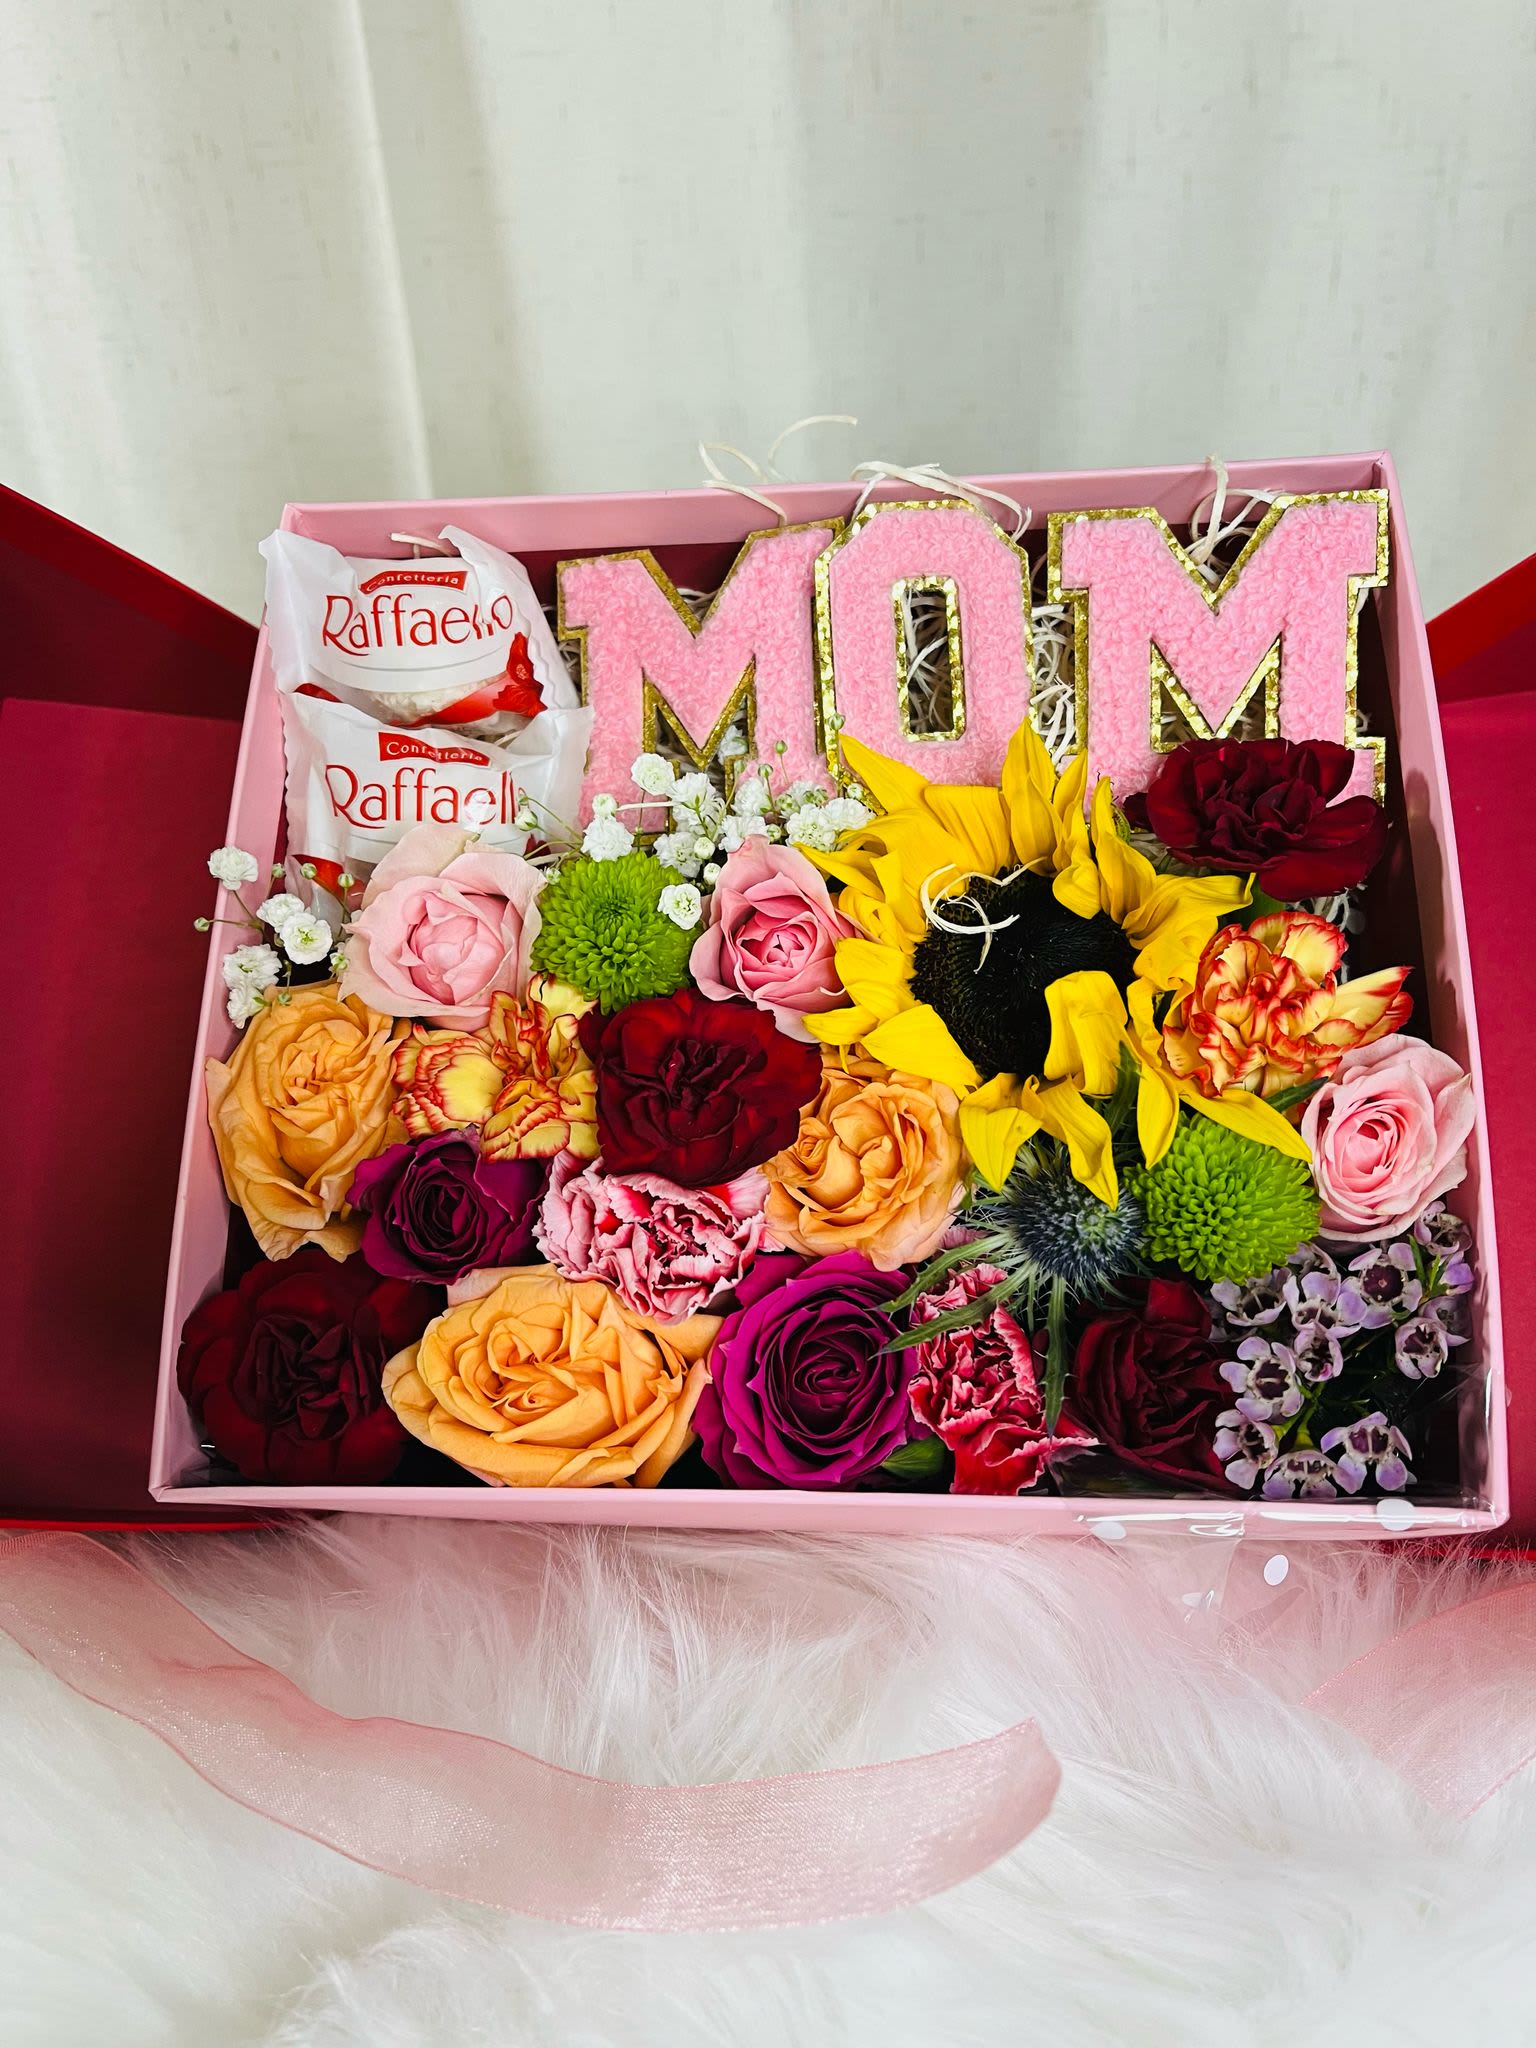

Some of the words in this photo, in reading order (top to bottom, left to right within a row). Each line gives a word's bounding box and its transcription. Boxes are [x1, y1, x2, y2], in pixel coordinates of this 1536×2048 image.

[366, 573, 459, 592] Confetteria
[322, 593, 513, 656] Raffaello
[557, 489, 1389, 833] MOM
